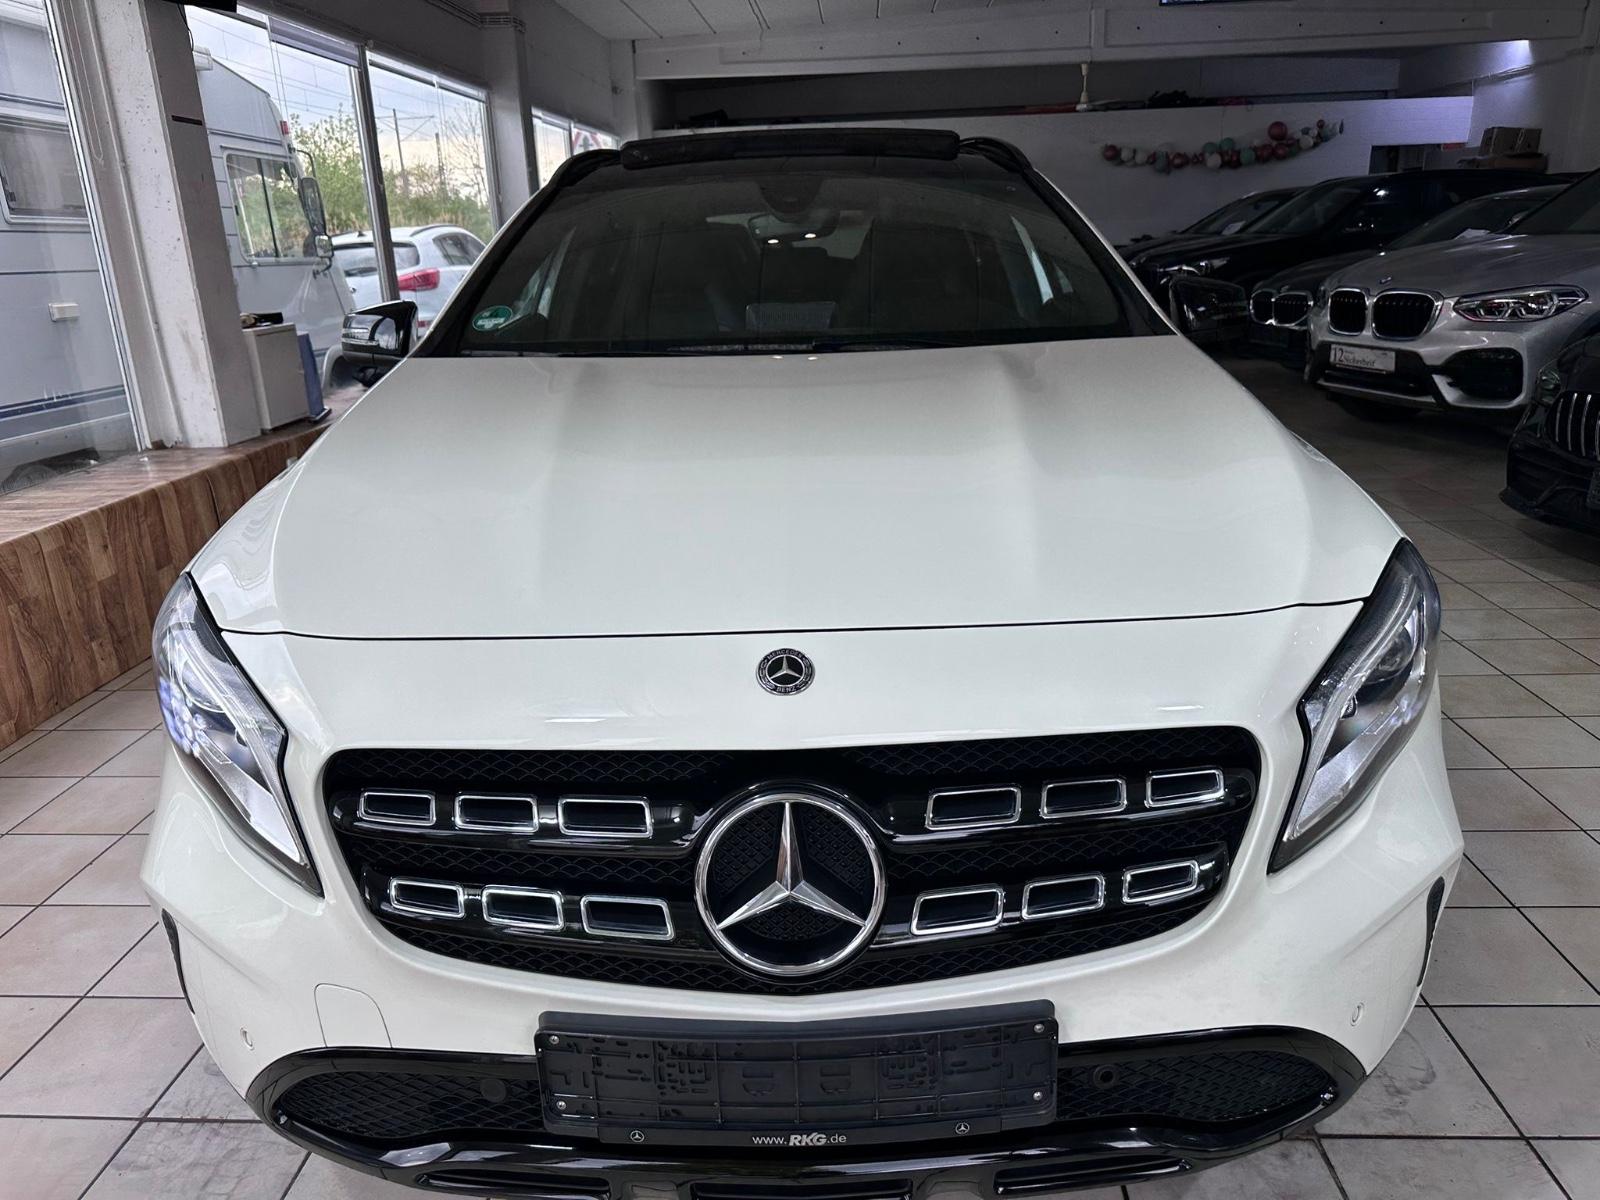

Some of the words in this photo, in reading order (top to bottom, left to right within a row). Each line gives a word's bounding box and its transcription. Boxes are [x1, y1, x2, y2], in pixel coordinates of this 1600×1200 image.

[1333, 347, 1344, 362] 12
[767, 649, 802, 660] MERCEDES
[751, 1131, 847, 1147] www.RKG.de
